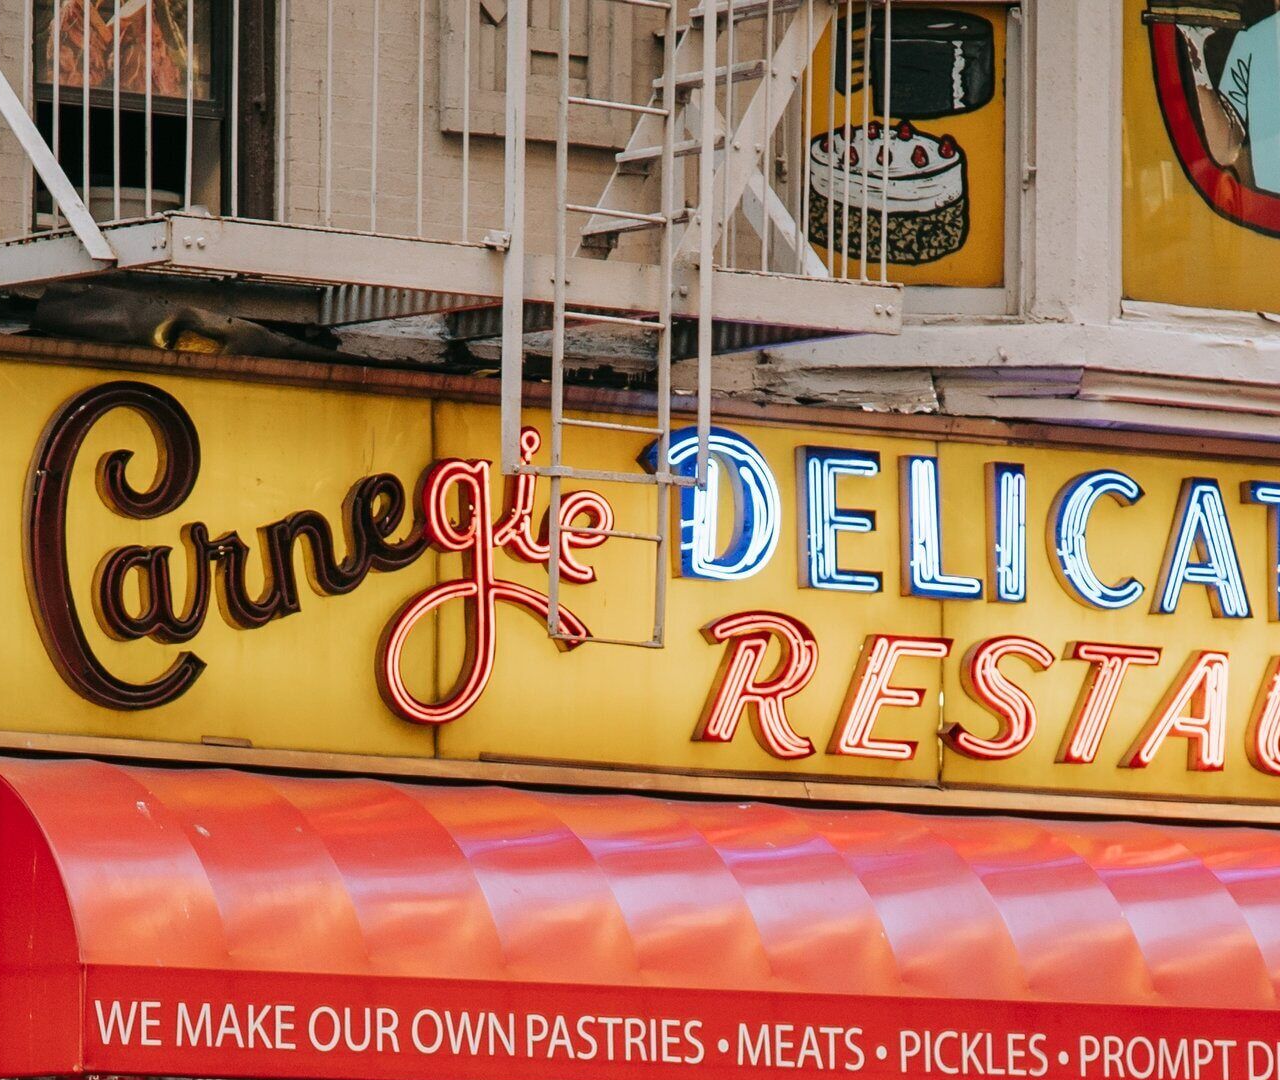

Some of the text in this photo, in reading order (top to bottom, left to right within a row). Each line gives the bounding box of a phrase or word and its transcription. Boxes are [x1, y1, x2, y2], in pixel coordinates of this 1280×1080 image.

[22, 380, 615, 725] Carnegie
[95, 1000, 161, 1046] WE
[175, 1003, 296, 1050] MAKE
[307, 1005, 400, 1054] OUR
[410, 1010, 517, 1057] OWN
[526, 1014, 704, 1064] PASTRIES
[738, 1024, 865, 1071] MEATS
[899, 1029, 1048, 1077] PICKLES
